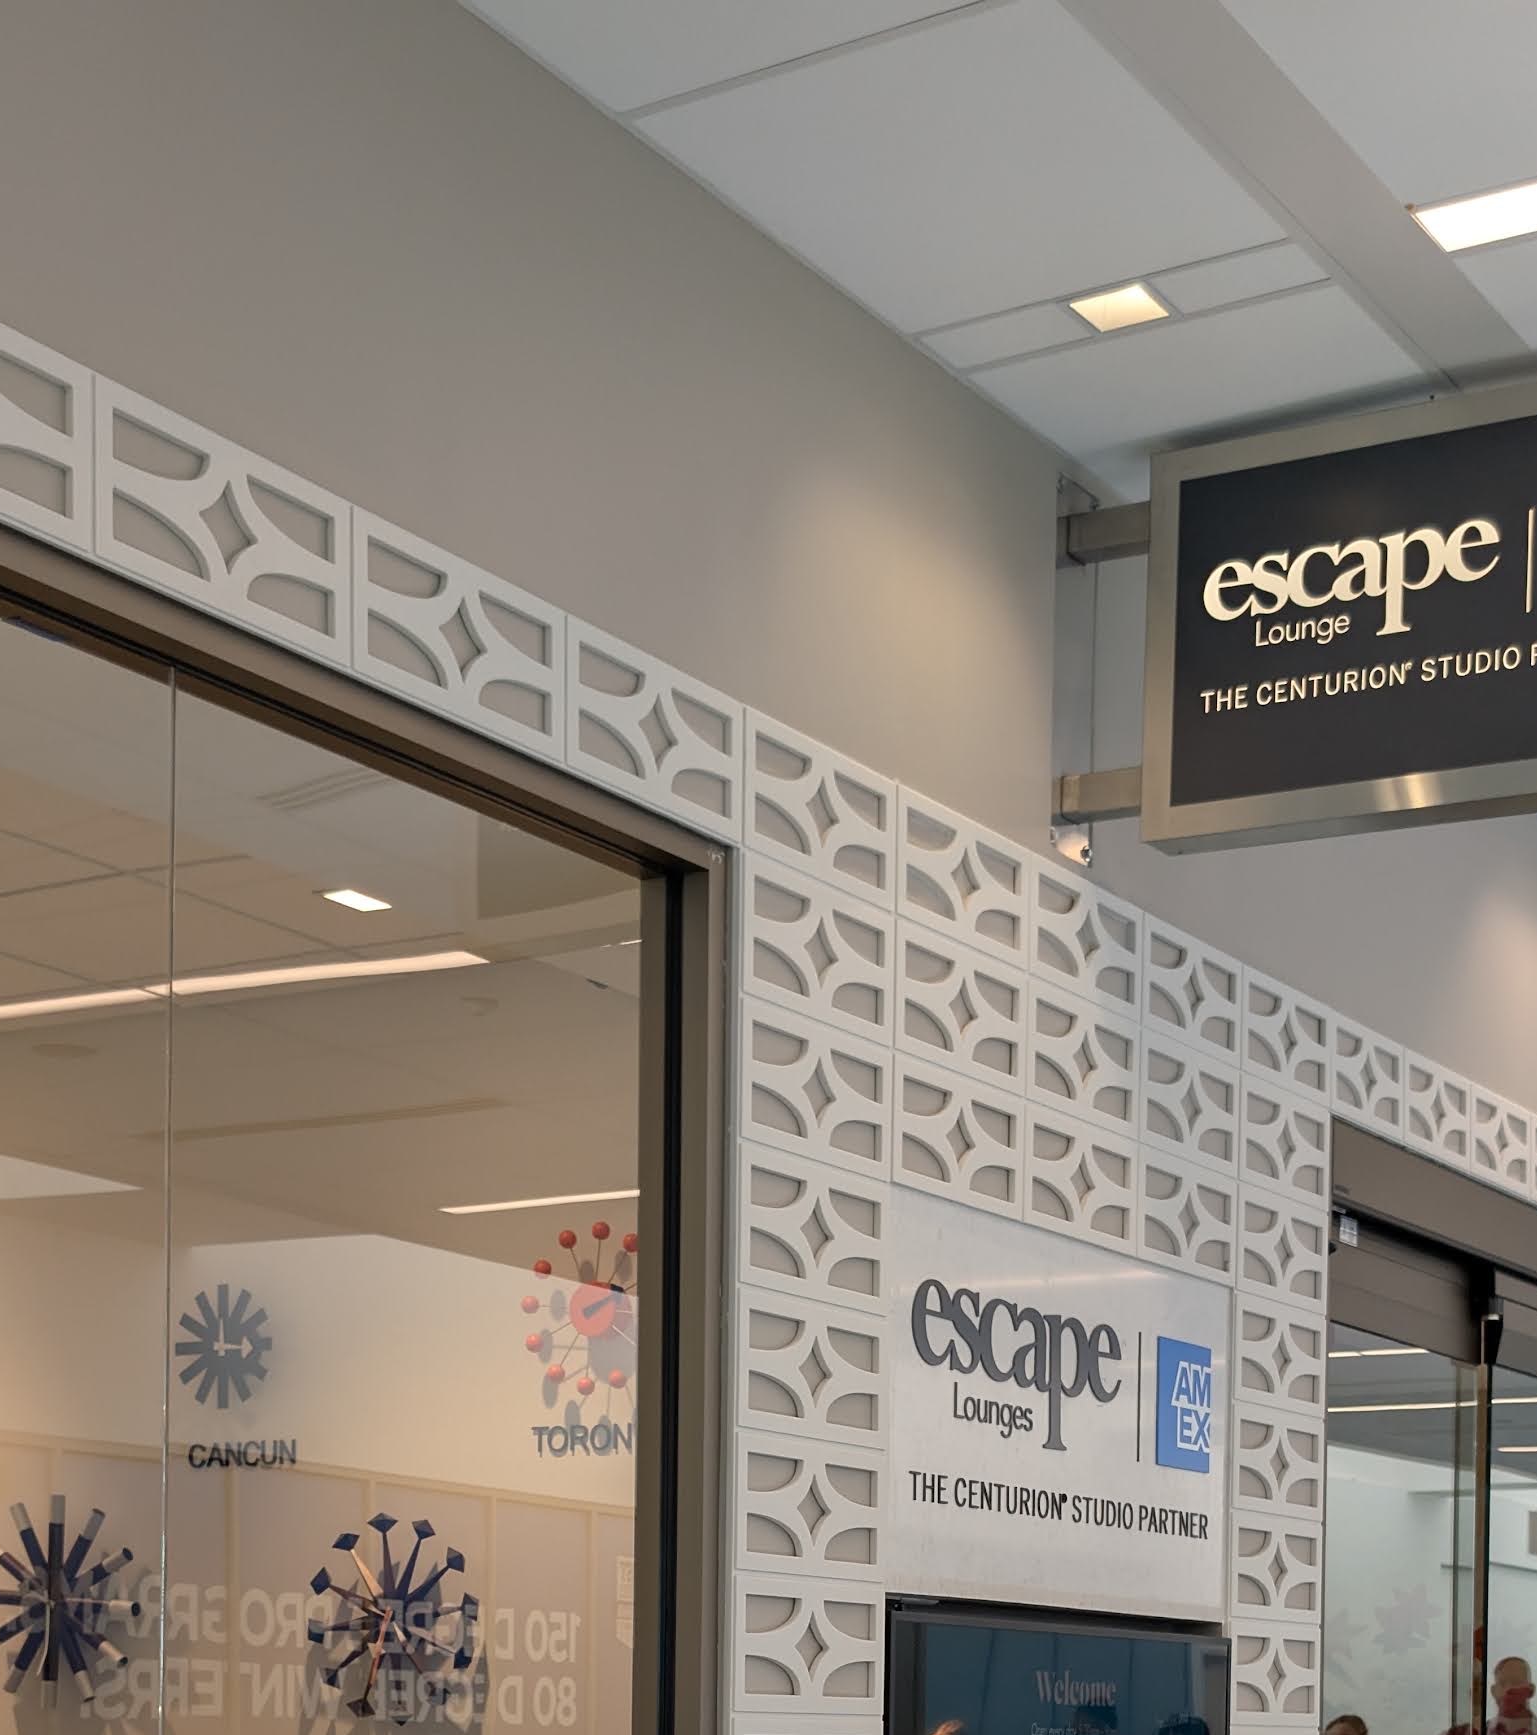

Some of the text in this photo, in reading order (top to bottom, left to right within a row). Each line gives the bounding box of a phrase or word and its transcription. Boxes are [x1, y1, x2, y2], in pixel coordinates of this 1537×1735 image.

[1203, 518, 1501, 636] escape
[1255, 613, 1351, 648] Lounge
[1200, 687, 1249, 714] THE
[1421, 645, 1521, 682] STUDIO
[911, 1279, 1122, 1451] escape
[953, 1381, 1034, 1438] Lounges
[188, 1439, 297, 1468] CANCUN
[908, 1470, 949, 1505] THE
[1072, 1495, 1133, 1531] STUDIO
[1138, 1505, 1209, 1540] PARTNER
[1035, 1669, 1117, 1706] Welcome
